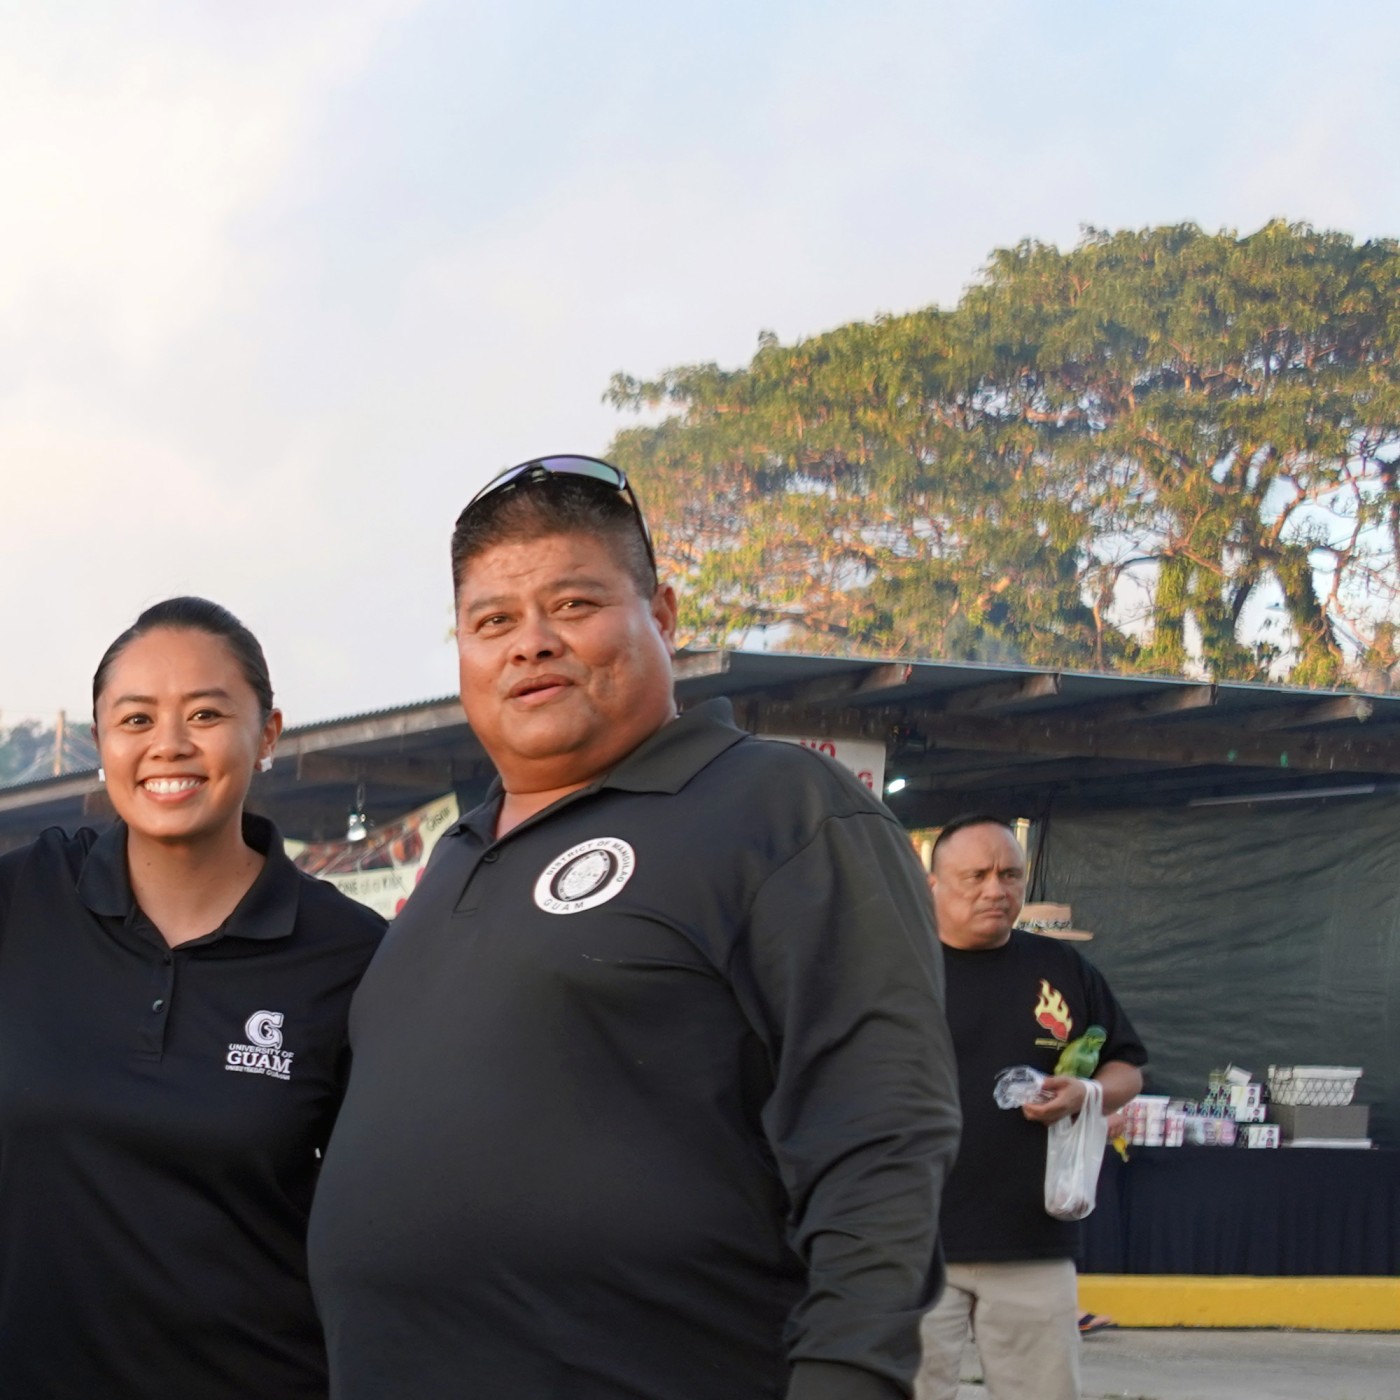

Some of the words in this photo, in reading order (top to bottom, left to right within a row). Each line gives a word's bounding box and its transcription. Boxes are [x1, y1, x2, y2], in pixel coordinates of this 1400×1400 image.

[546, 842, 593, 876] DISTRICT
[612, 842, 631, 883] MANGILAO
[543, 898, 584, 911] GUAM
[228, 1044, 281, 1056] UNIVERSITY
[281, 1050, 294, 1059] OF
[227, 1050, 293, 1074] GUAM
